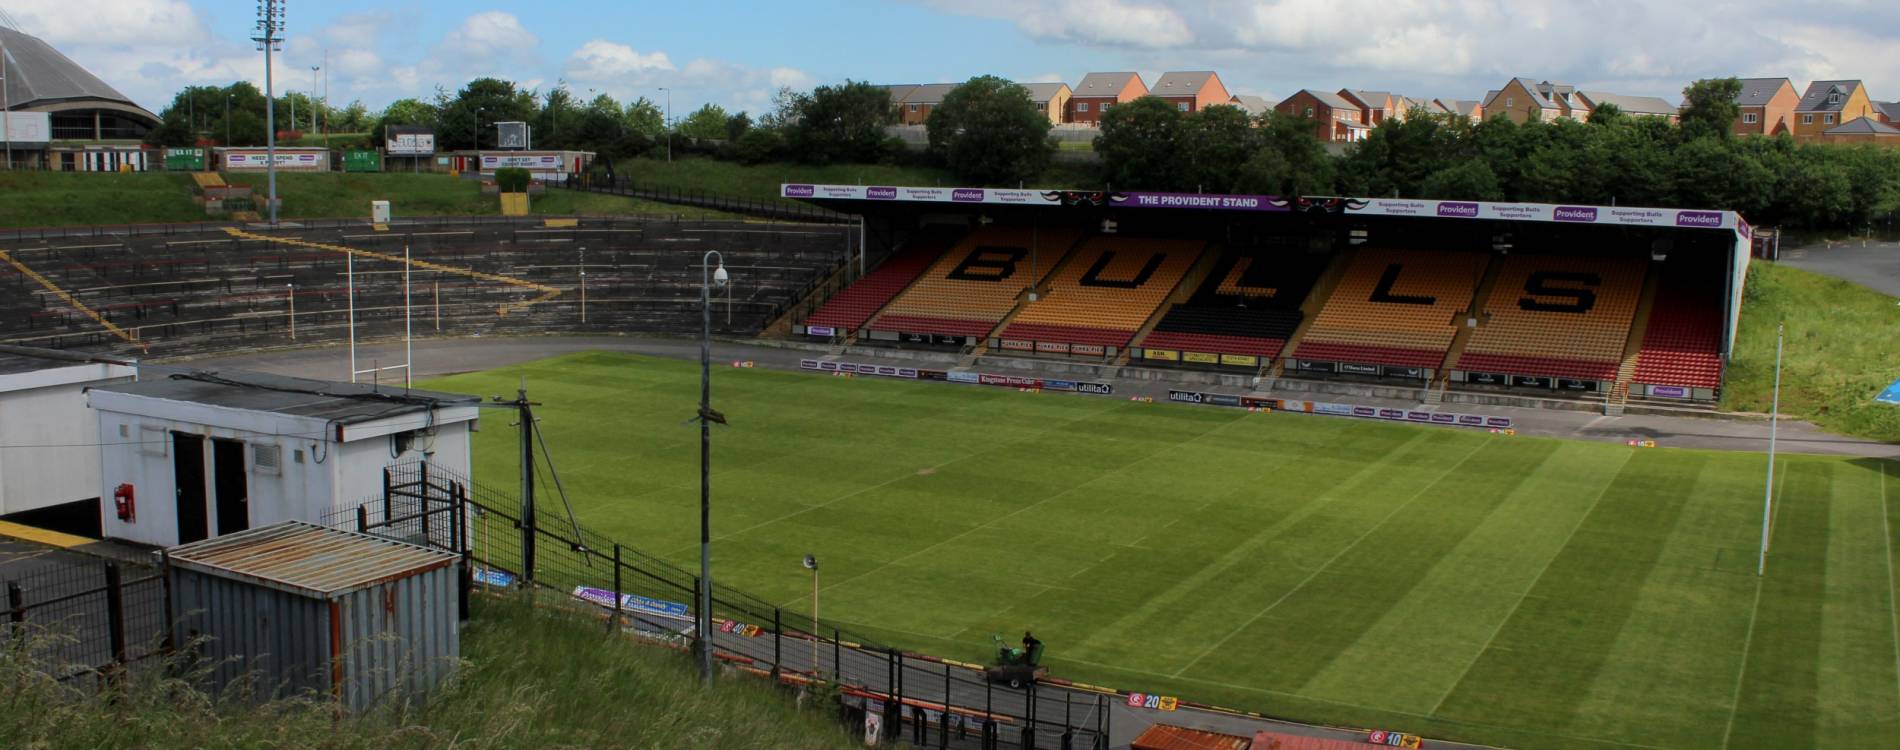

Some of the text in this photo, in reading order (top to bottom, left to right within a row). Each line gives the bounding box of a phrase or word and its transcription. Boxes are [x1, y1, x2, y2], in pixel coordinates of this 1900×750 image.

[787, 187, 813, 195] Provident
[868, 189, 895, 198] Provident
[954, 191, 982, 199] Provident
[1138, 195, 1258, 208] THE PROVIDENT STAND
[1440, 205, 1476, 214] Provident
[1556, 210, 1594, 220] Provident
[1679, 214, 1719, 225] Provident
[1078, 382, 1101, 393] utilita
[1170, 391, 1194, 402] utilita
[1144, 695, 1159, 709] 20
[1388, 733, 1401, 746] 10
